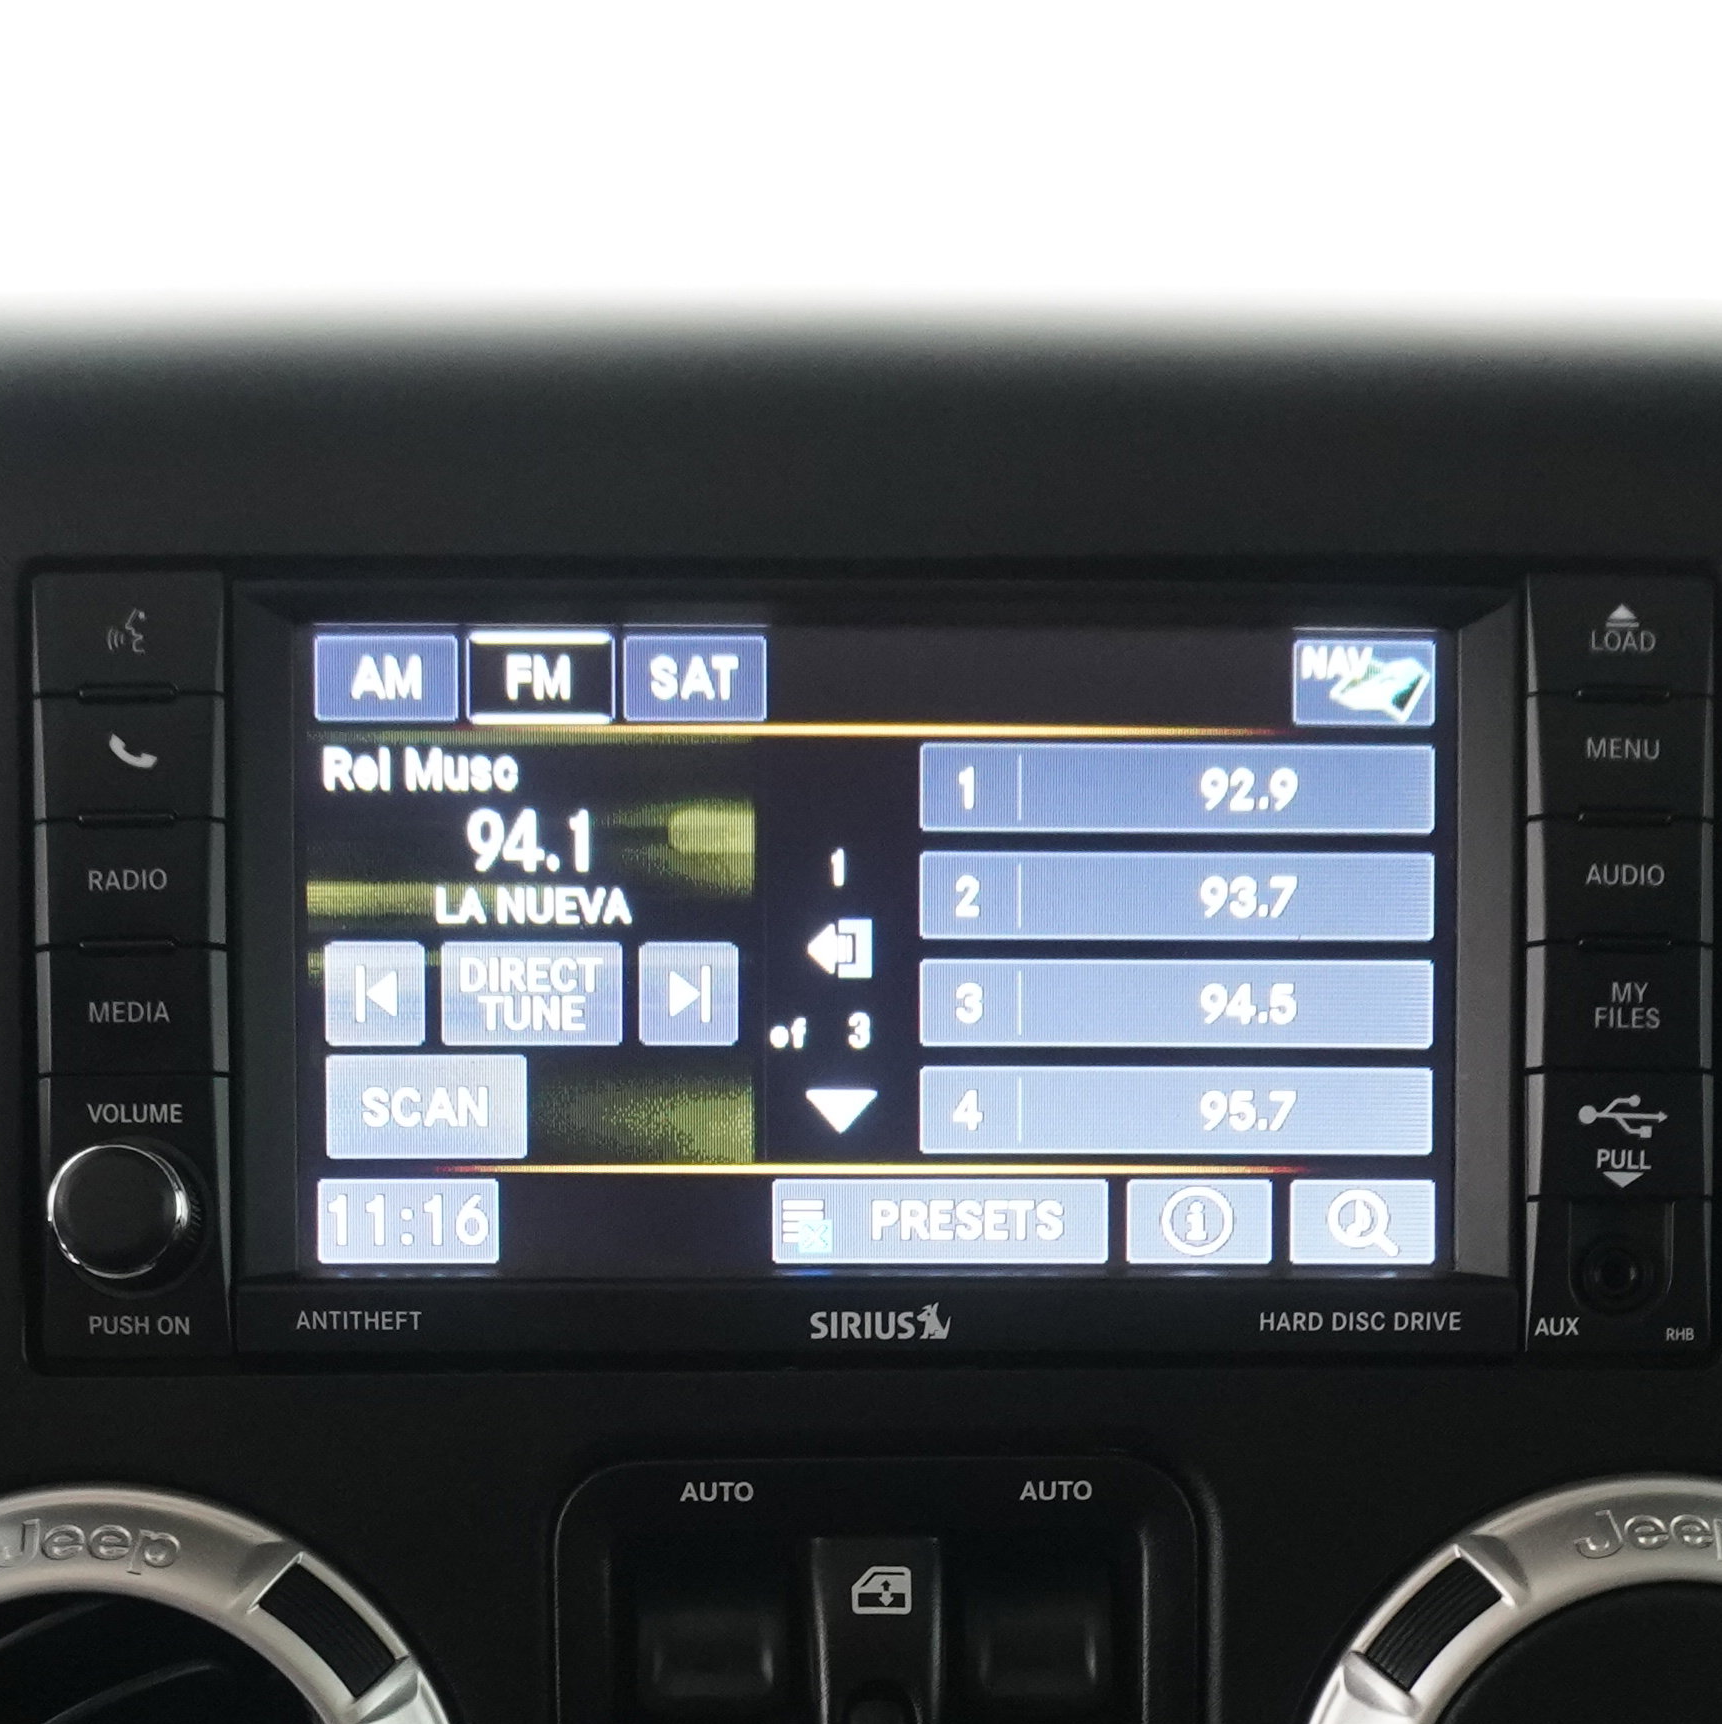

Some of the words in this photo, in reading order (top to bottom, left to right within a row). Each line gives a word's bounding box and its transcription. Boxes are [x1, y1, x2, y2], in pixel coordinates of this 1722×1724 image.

[1590, 630, 1657, 652] LOAD
[350, 654, 423, 700] AM
[504, 654, 572, 700] FM
[649, 654, 739, 700] SAT
[1301, 645, 1374, 680] NAV
[1586, 737, 1661, 760] MENU
[404, 746, 519, 792] Musc
[958, 766, 977, 809] 1
[1200, 767, 1299, 812] 92.9
[466, 807, 591, 873] 94.1
[87, 867, 169, 892] RADIO
[829, 847, 846, 888] 1
[1585, 863, 1665, 887] AUDIO
[435, 886, 486, 925] LA
[497, 886, 633, 925] NUEVA
[953, 874, 980, 919] 2
[1200, 874, 1298, 919] 93.7
[459, 956, 604, 994] DIRECT
[1611, 981, 1649, 1004] MY
[87, 1001, 171, 1025] MEDIA
[478, 995, 587, 1032] TUNE
[954, 981, 984, 1024] 3
[1200, 981, 1298, 1024] 94.5
[1594, 1007, 1661, 1030] FILES
[770, 1017, 807, 1050] of
[847, 1011, 871, 1050] 3
[86, 1103, 183, 1124] VOLUME
[361, 1085, 490, 1130] SCAN
[951, 1089, 984, 1133] 4
[1200, 1089, 1298, 1133] 95.7
[1596, 1148, 1652, 1170] PULL
[327, 1194, 490, 1247] 11:16
[871, 1199, 1065, 1243] PRESETS
[89, 1315, 150, 1335] PUSH
[156, 1315, 191, 1335] ON
[296, 1311, 422, 1331] ANTITHEFT
[810, 1310, 915, 1340] SIRIUS
[1259, 1311, 1323, 1332] HARD
[1331, 1311, 1386, 1332] DISC
[1394, 1311, 1462, 1332] DRIVE
[1534, 1316, 1579, 1337] AUX
[1665, 1328, 1694, 1342] RHB
[680, 1481, 754, 1503] AUTO
[1019, 1480, 1093, 1502] AUTO
